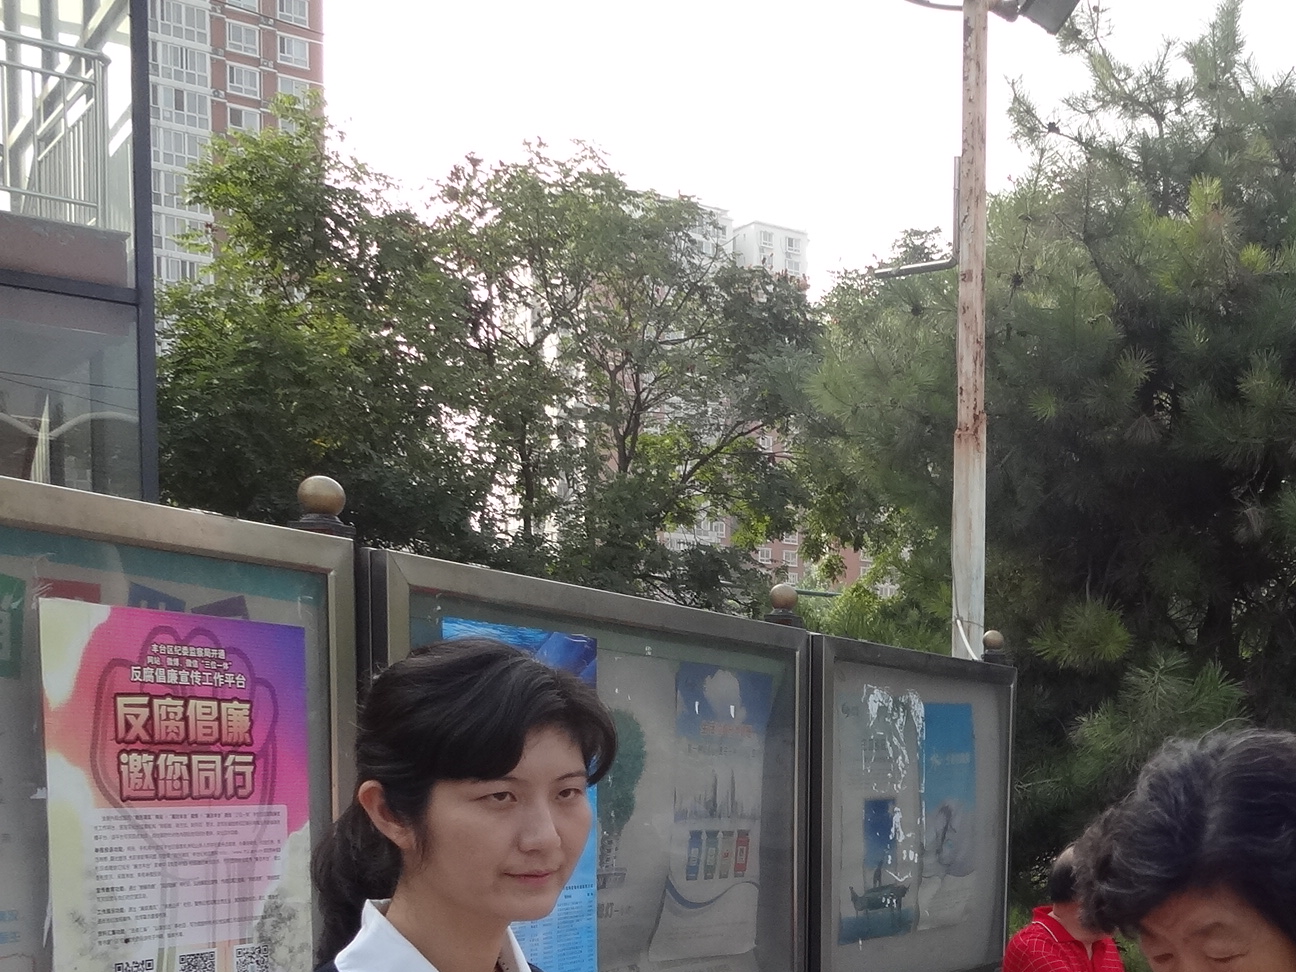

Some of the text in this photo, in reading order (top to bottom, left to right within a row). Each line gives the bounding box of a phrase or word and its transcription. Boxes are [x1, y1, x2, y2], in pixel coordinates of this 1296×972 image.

[130, 666, 246, 688] 反腐倡廉宣传工作平台
[114, 694, 252, 744] 反腐倡廉
[118, 750, 255, 801] 邀您同行
